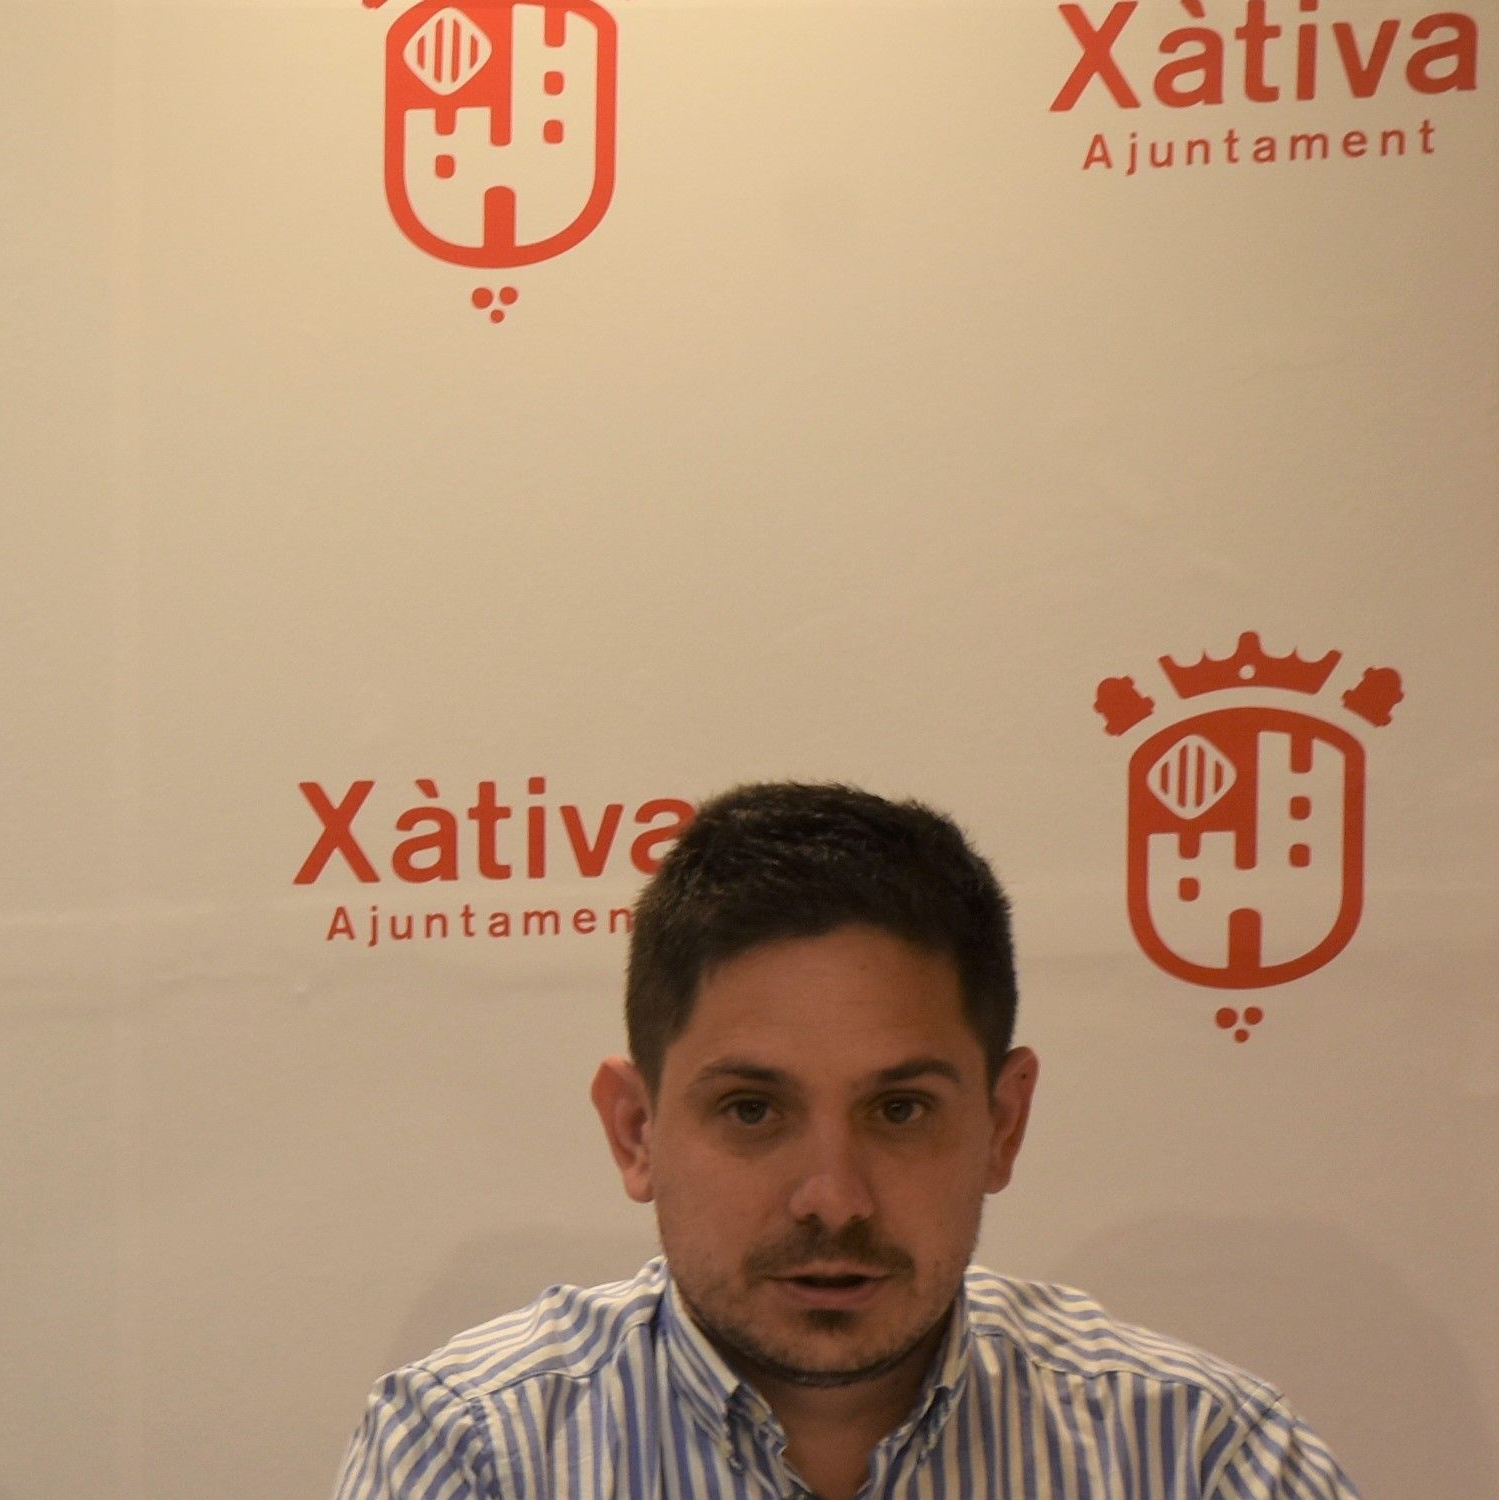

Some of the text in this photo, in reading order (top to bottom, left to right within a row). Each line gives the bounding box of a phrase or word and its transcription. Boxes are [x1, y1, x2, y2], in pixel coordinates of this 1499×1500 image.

[1049, 0, 1481, 112] Xàtiva
[1082, 119, 1437, 177] Ajuntament
[292, 775, 699, 886] Xàtiva
[325, 904, 633, 948] Ajuntamen
